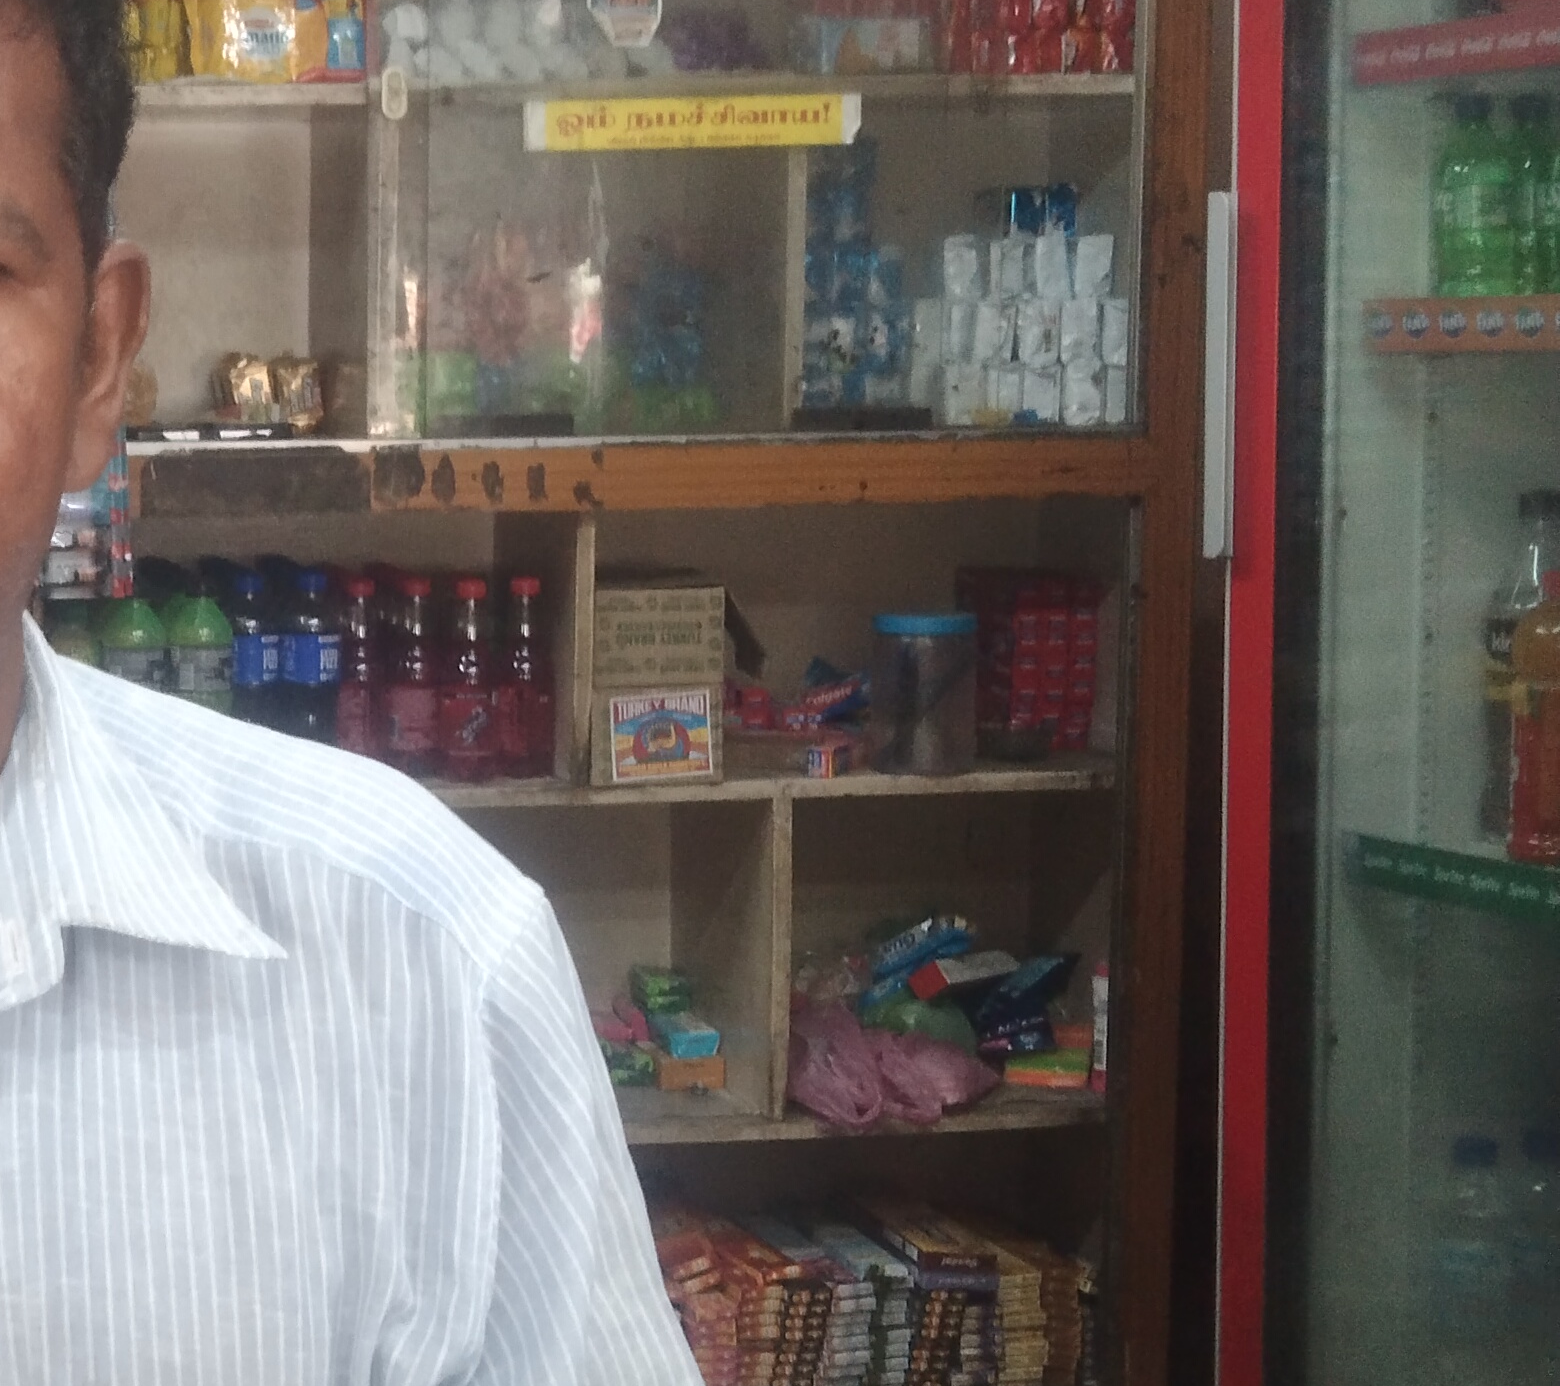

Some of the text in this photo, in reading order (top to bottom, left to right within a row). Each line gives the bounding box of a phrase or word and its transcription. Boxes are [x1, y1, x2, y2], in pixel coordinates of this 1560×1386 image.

[556, 106, 616, 138] ஓம்
[616, 695, 705, 722] TURKEY BRAND
